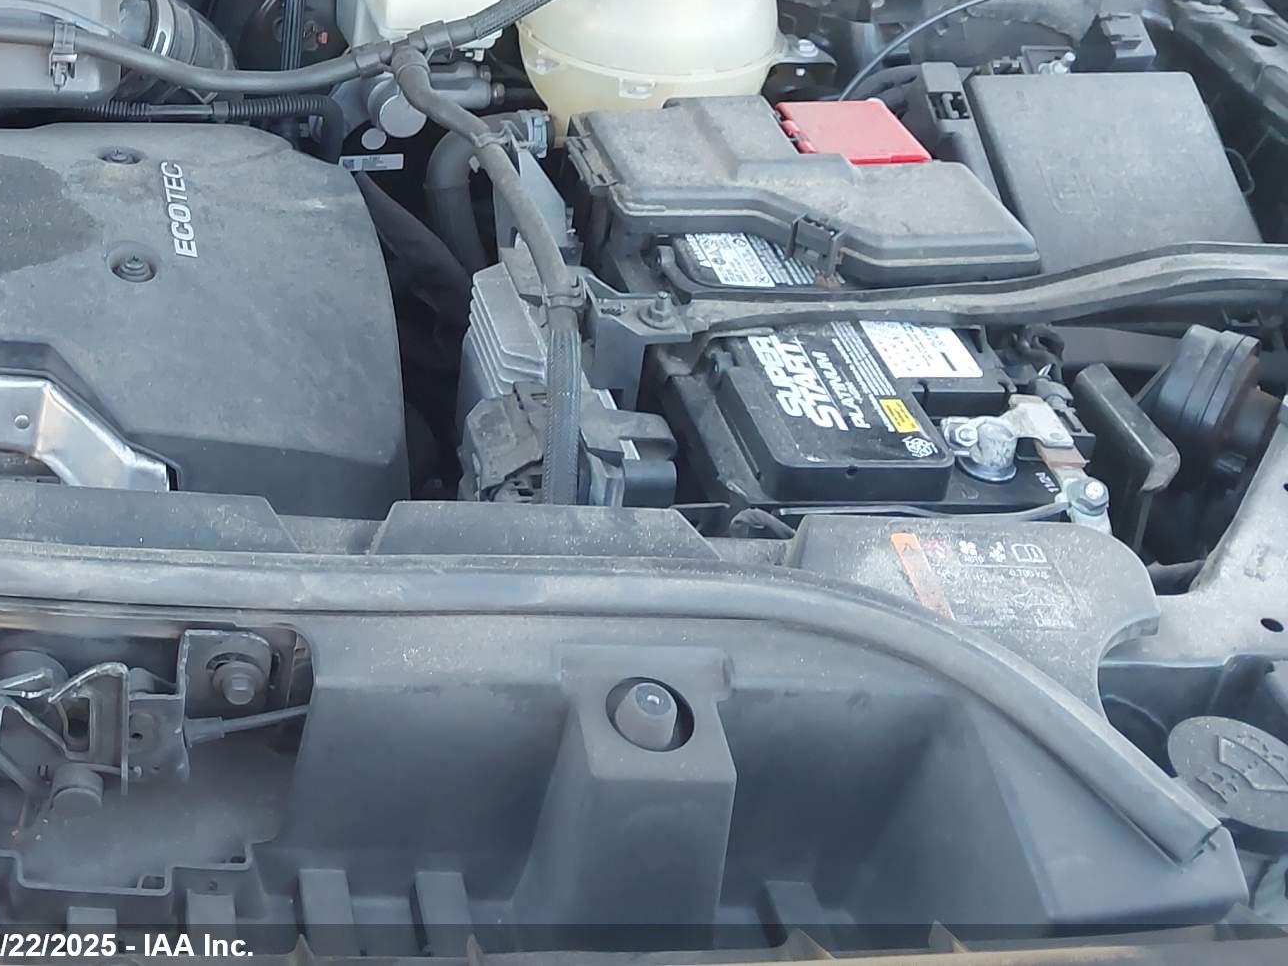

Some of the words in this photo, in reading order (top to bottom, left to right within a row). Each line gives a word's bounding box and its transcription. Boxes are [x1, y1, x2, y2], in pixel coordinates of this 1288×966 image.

[160, 161, 198, 257] ECOTEC
[748, 335, 804, 417] SUPER
[769, 334, 849, 431] START
[812, 350, 871, 429] PLATINUM
